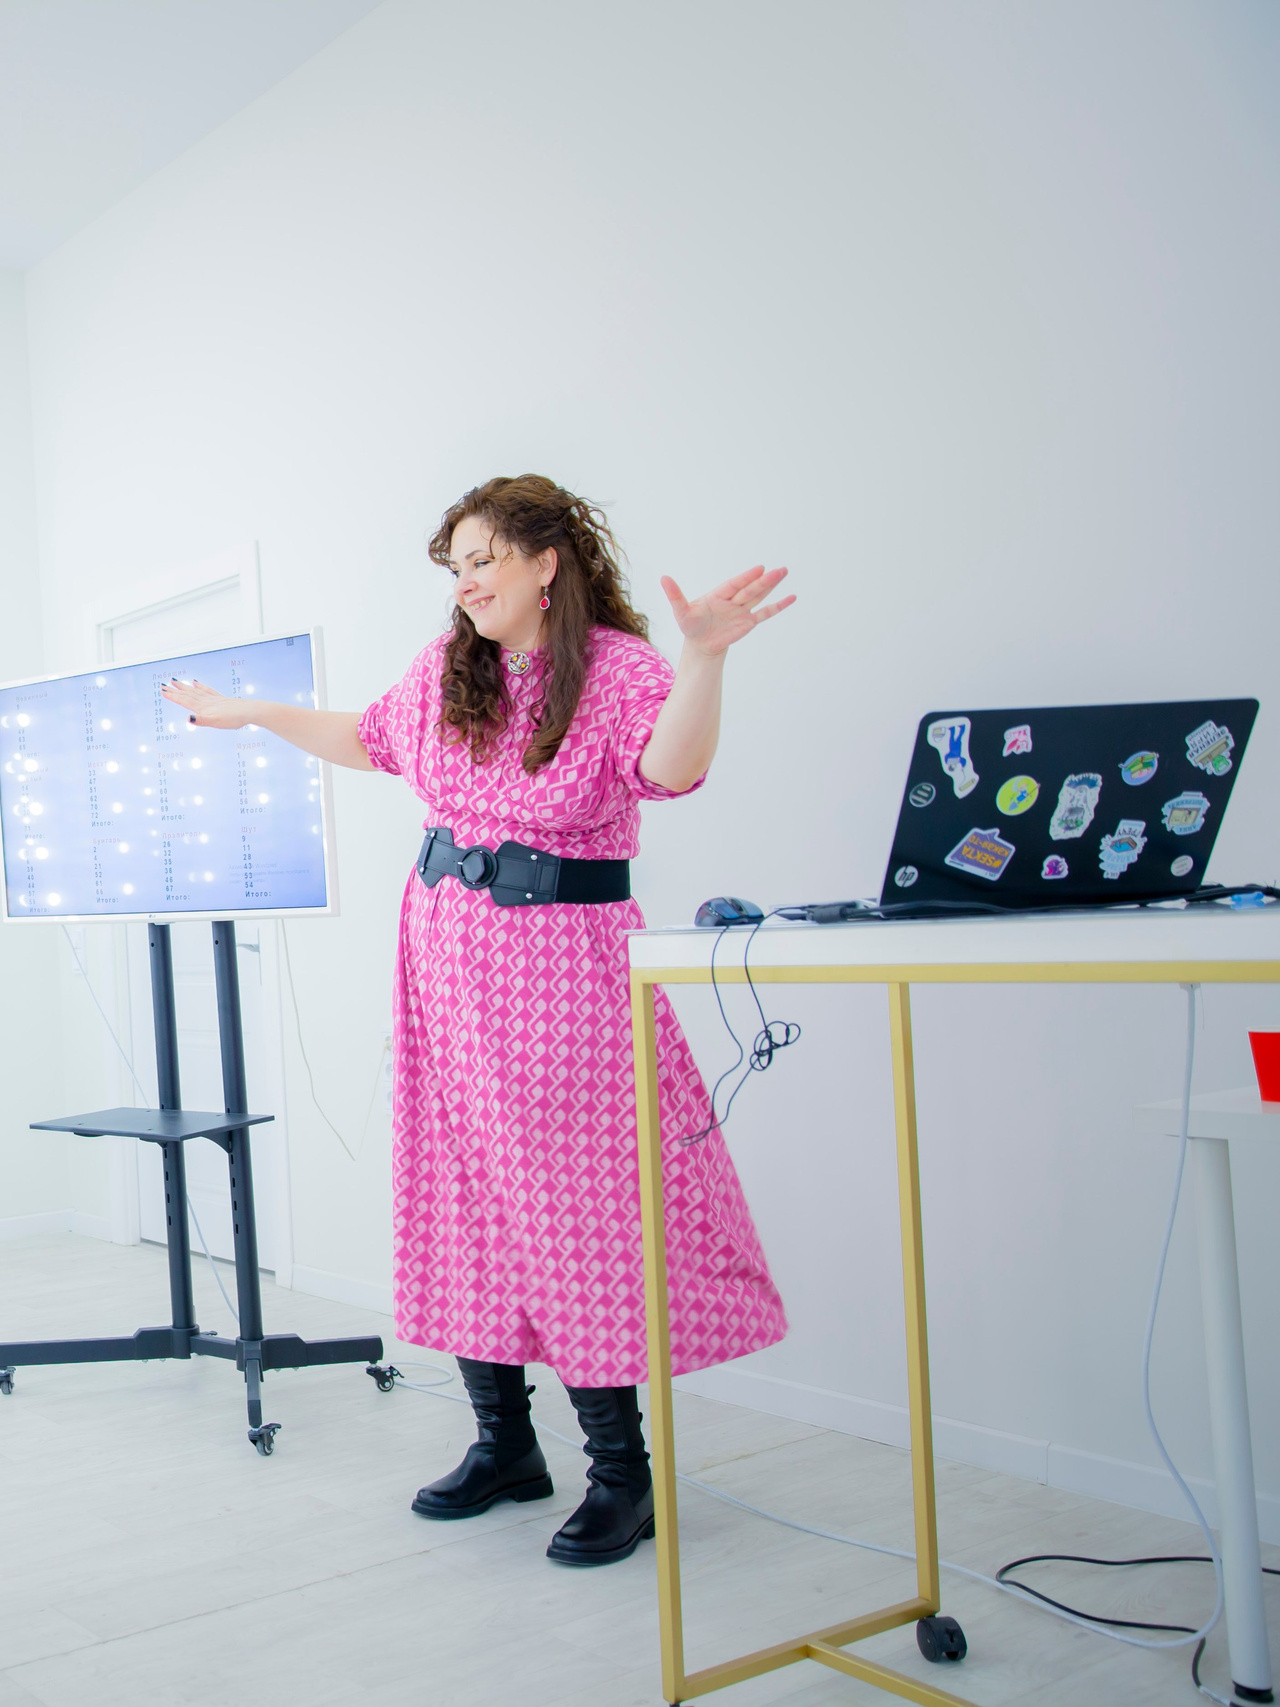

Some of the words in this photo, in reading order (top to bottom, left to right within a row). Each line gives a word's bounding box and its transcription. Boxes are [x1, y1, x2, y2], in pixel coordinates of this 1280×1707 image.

[152, 669, 187, 680] Любящий
[232, 677, 241, 685] 23
[232, 686, 241, 694] 37
[156, 734, 179, 742] Итого:
[86, 743, 109, 751] Итого:
[236, 741, 266, 750] Мудрец
[237, 760, 246, 768] 18
[238, 769, 247, 778] 20
[239, 788, 247, 796] 41
[239, 797, 249, 805] 56
[241, 826, 257, 834] Шут
[243, 853, 252, 861] 28
[243, 862, 253, 870] 43
[244, 872, 253, 880] 53
[897, 866, 915, 888] hp
[244, 881, 254, 889] 54
[245, 890, 272, 898] Итого:
